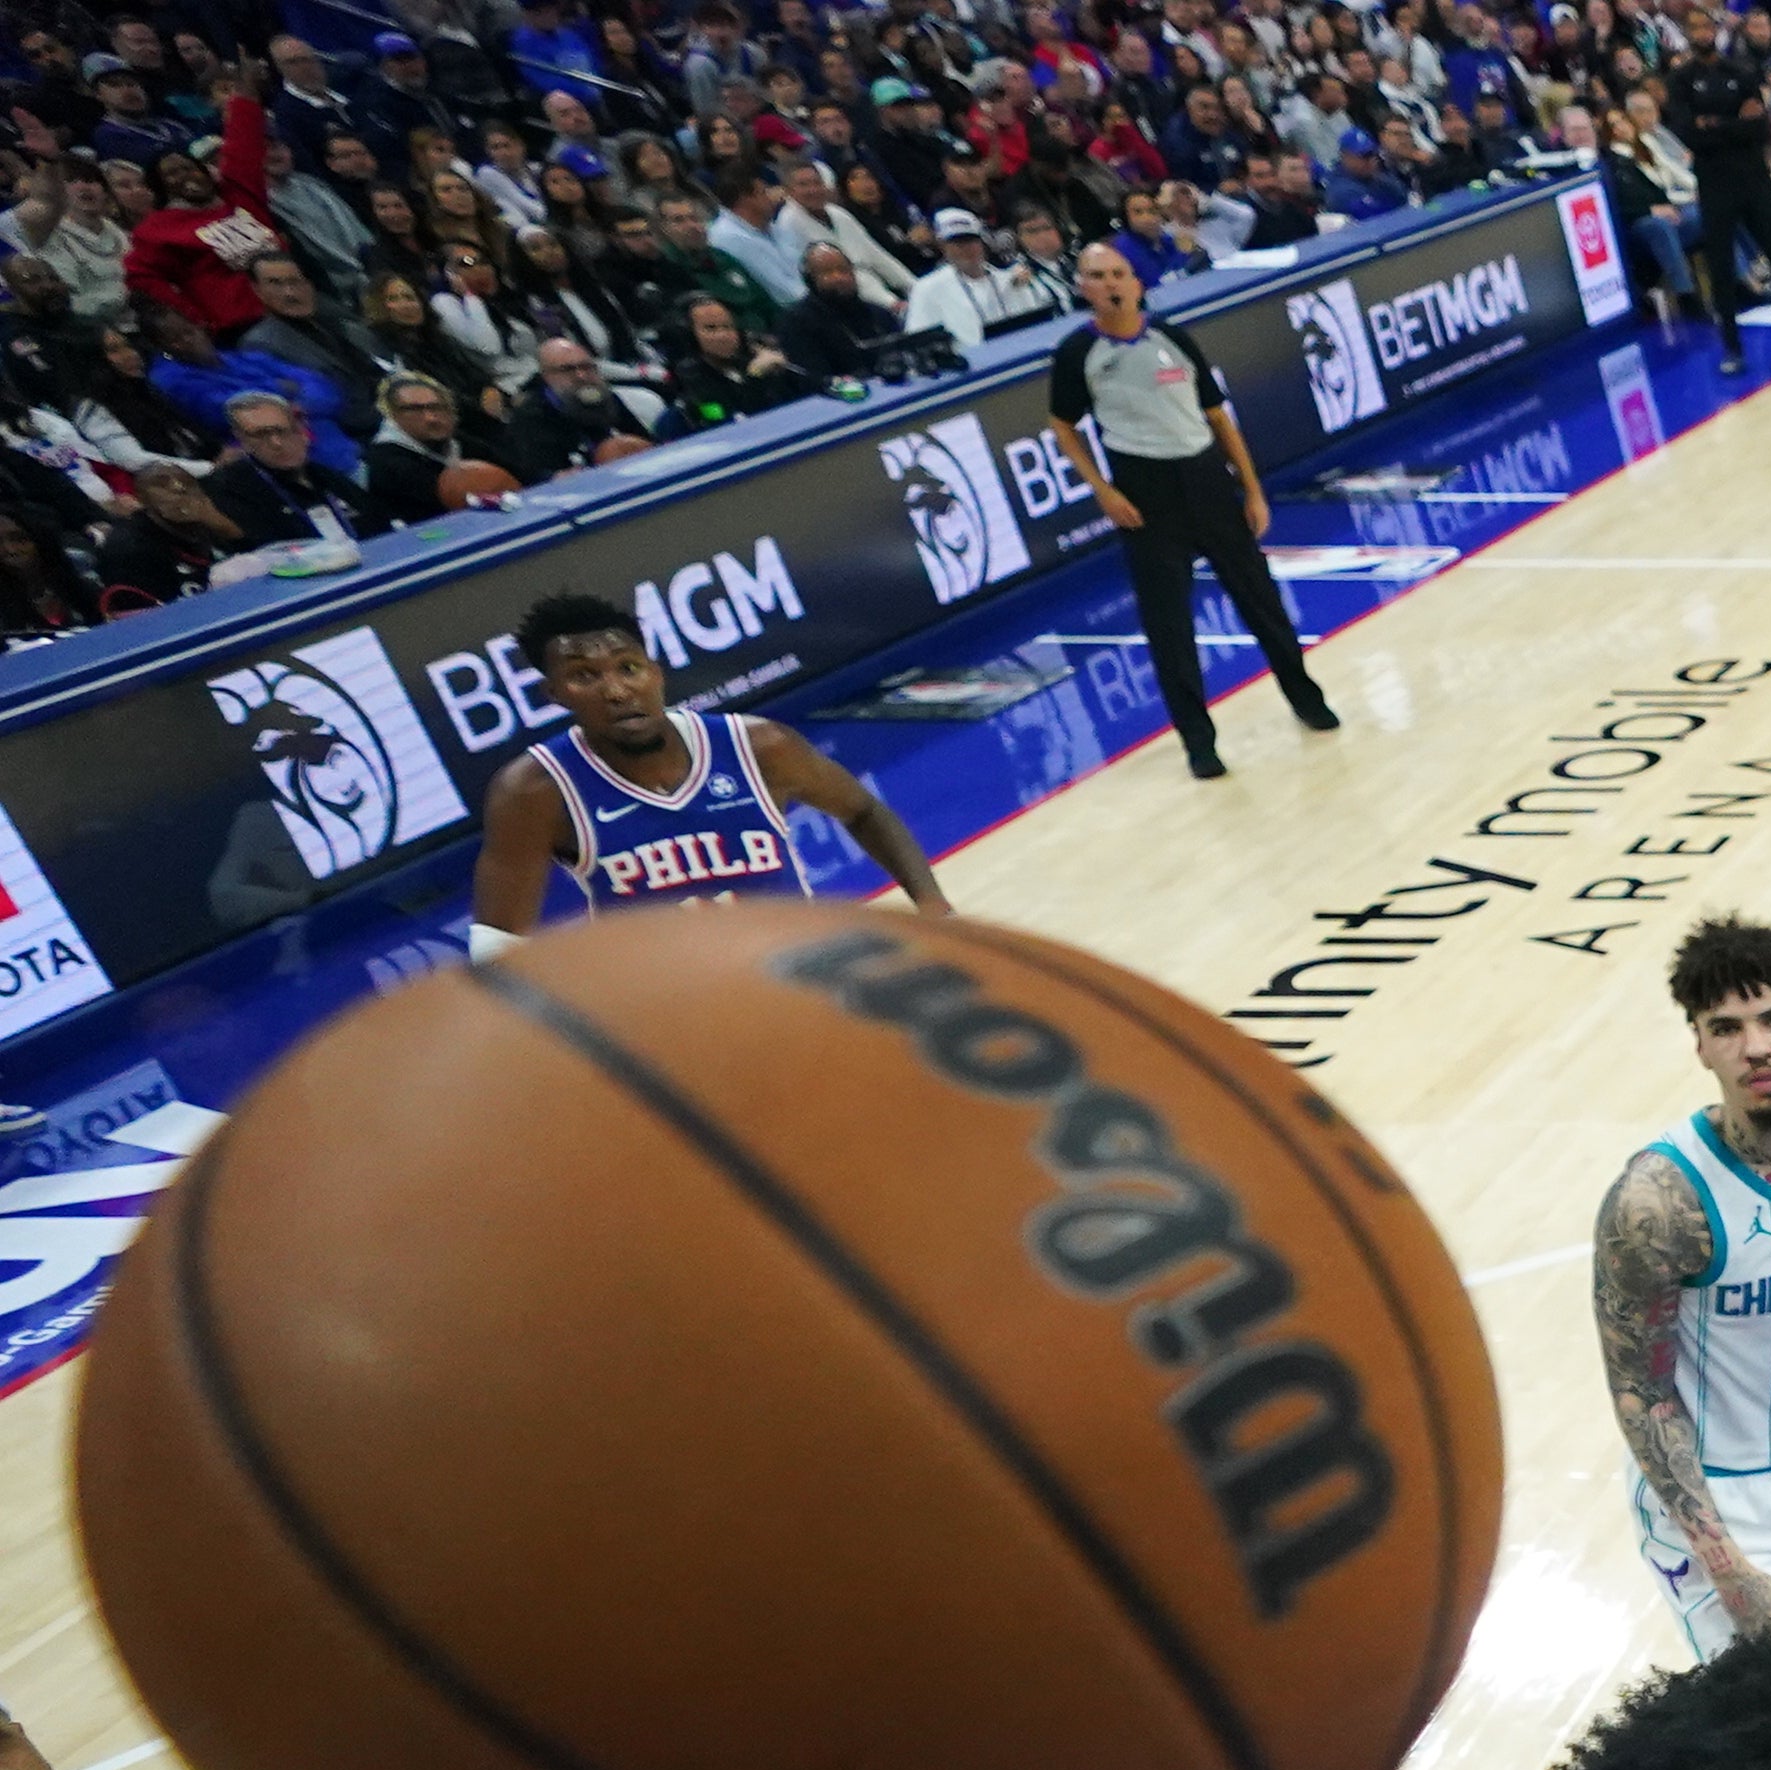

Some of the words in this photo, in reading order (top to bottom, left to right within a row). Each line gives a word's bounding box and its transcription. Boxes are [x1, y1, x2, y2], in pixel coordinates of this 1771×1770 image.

[1369, 253, 1530, 370] BETMGM
[425, 535, 806, 754] BEMGM
[598, 830, 783, 896] PHILA
[0, 938, 87, 998] OTA
[764, 925, 1397, 1630] Wilson
